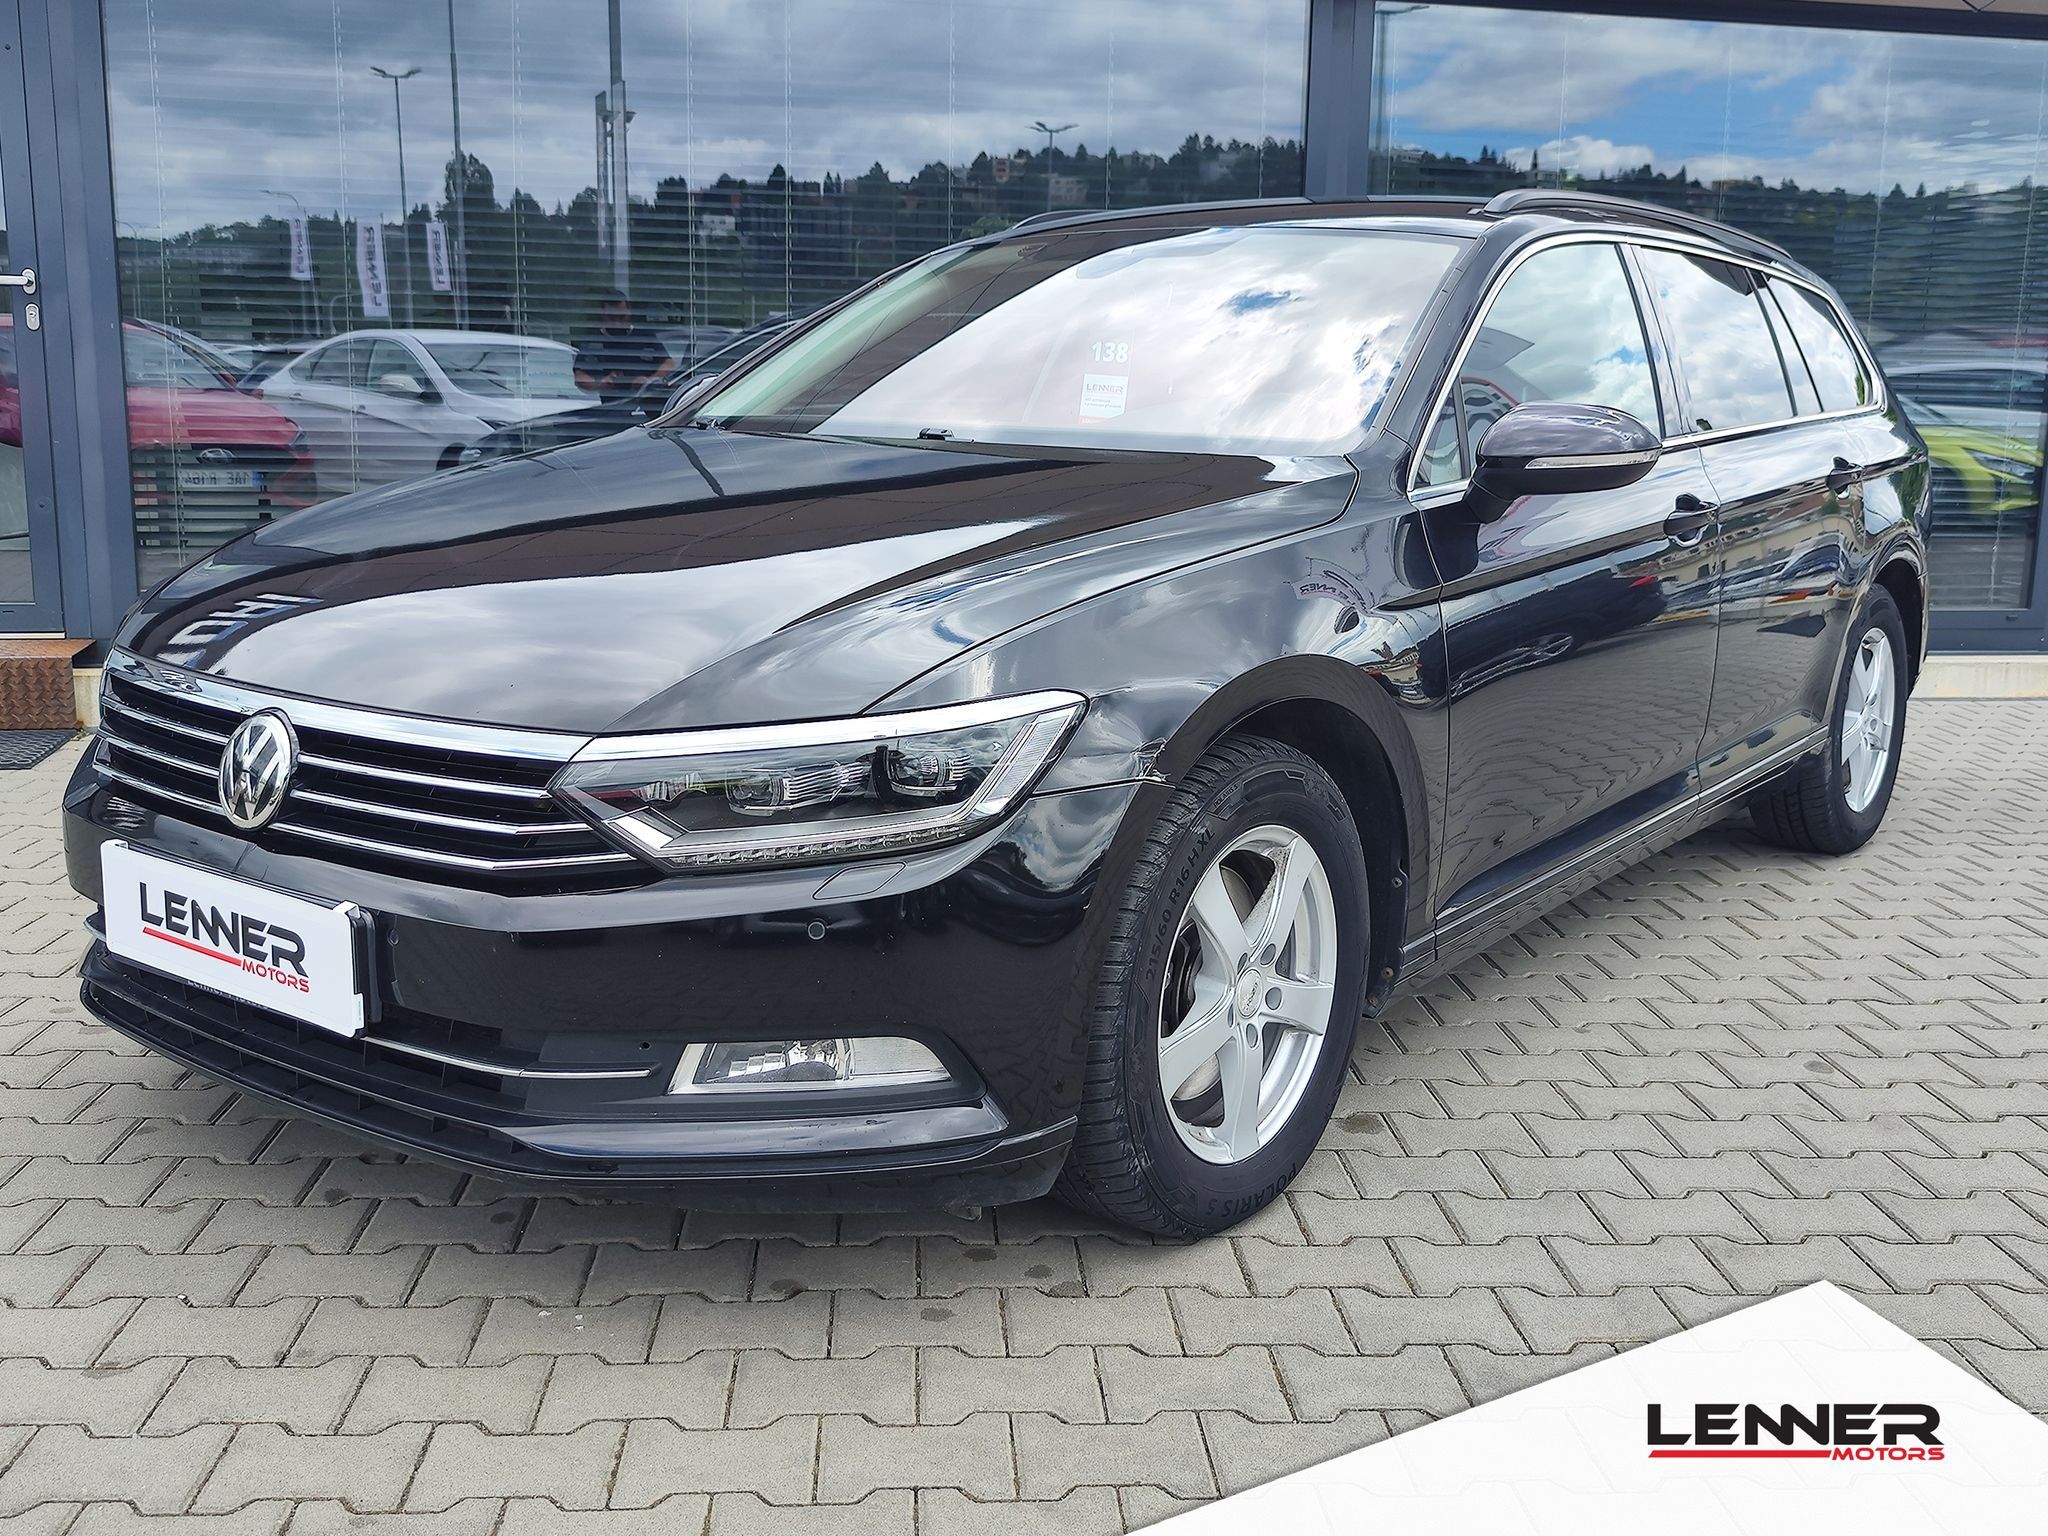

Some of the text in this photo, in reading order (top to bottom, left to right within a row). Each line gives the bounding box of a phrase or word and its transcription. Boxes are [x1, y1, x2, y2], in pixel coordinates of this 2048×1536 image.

[1091, 341, 1129, 363] 138
[1086, 383, 1124, 394] LENNER
[1146, 828, 1216, 981] 215/60 R16 H XL
[139, 881, 309, 977] LENNER
[241, 959, 310, 993] MOTORS
[1221, 1162, 1297, 1218] POLARIS
